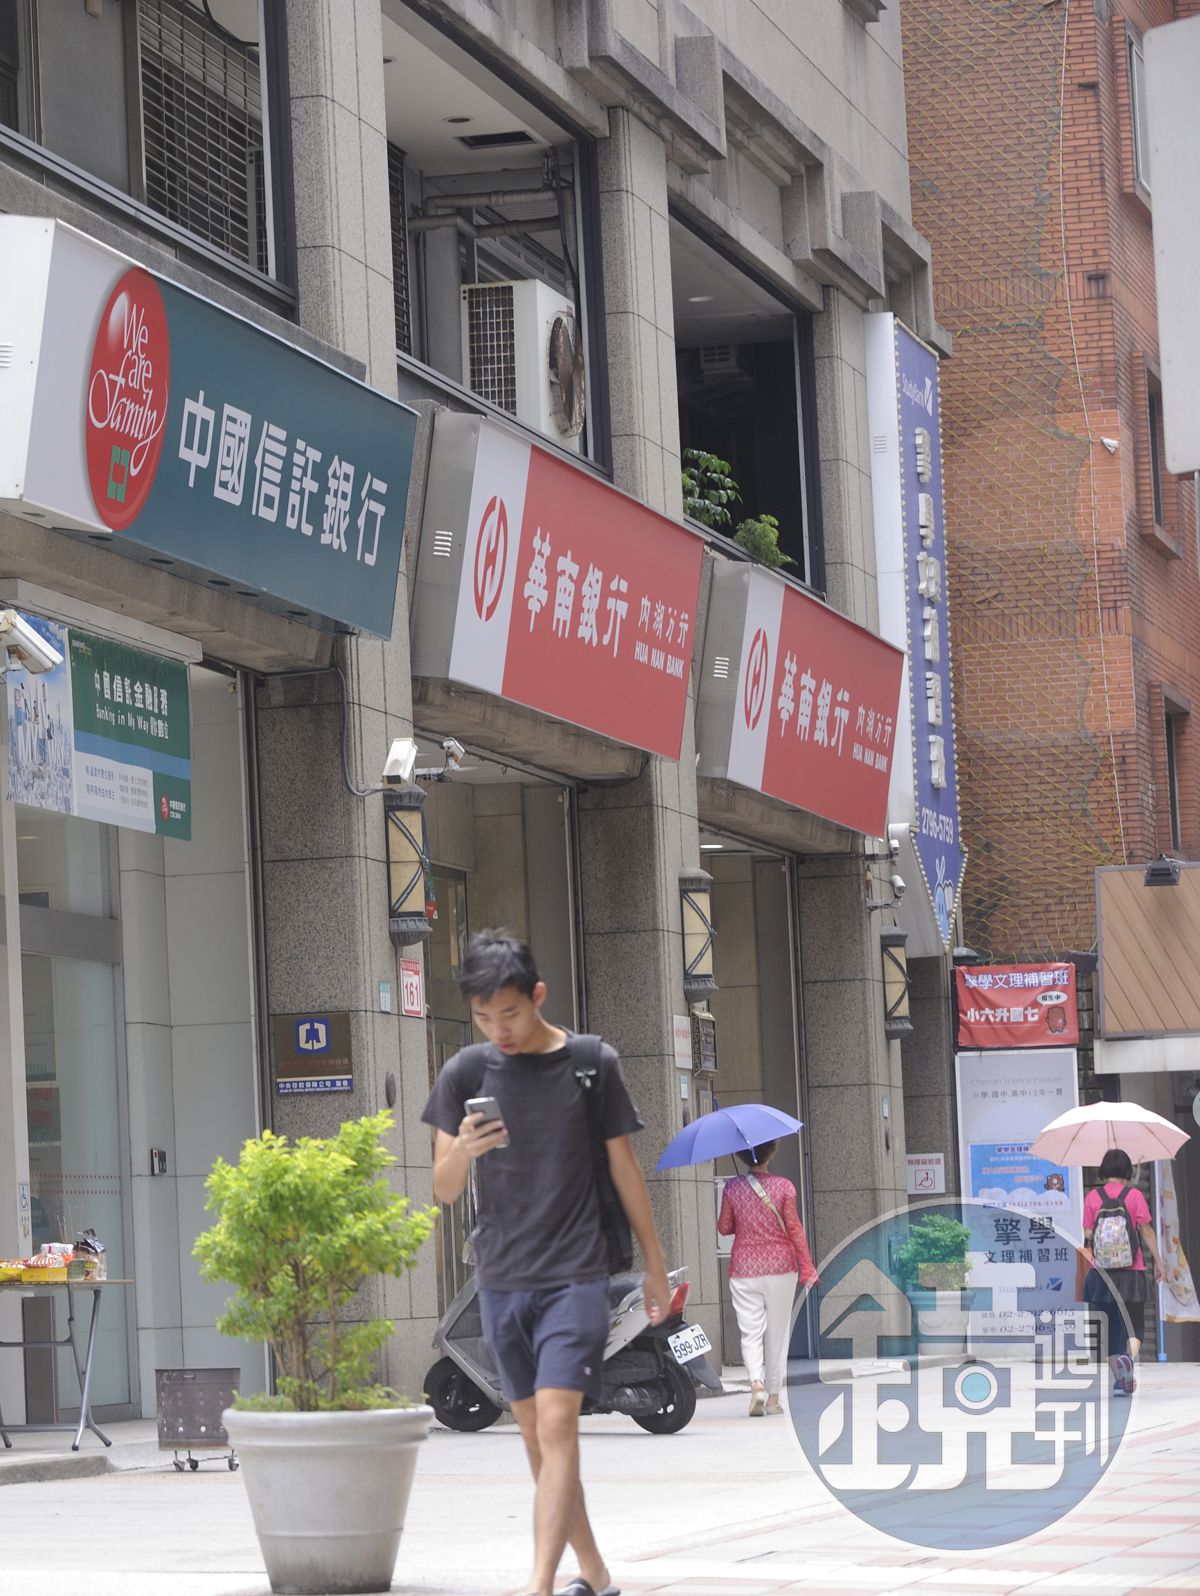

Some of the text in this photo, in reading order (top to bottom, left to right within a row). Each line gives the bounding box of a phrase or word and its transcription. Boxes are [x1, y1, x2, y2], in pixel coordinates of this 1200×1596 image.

[121, 303, 148, 354] We
[88, 370, 168, 477] Family
[178, 390, 388, 567] 中國信託銀行
[523, 526, 629, 658] 華南銀行
[638, 593, 689, 648] 內湖分行
[634, 640, 684, 679] HUA NAN BANK
[96, 704, 115, 726] Banking
[117, 709, 126, 725] in
[127, 711, 136, 730] My
[137, 715, 149, 734] Way
[777, 650, 850, 757] 華南銀行
[853, 741, 888, 773] HUA NAN BANK
[921, 807, 954, 845] 2796-5759
[405, 982, 420, 1007] 161
[967, 1007, 1039, 1023] 小六升國七
[994, 1216, 1056, 1246] 擎學
[984, 1247, 1069, 1264] 文理補習班
